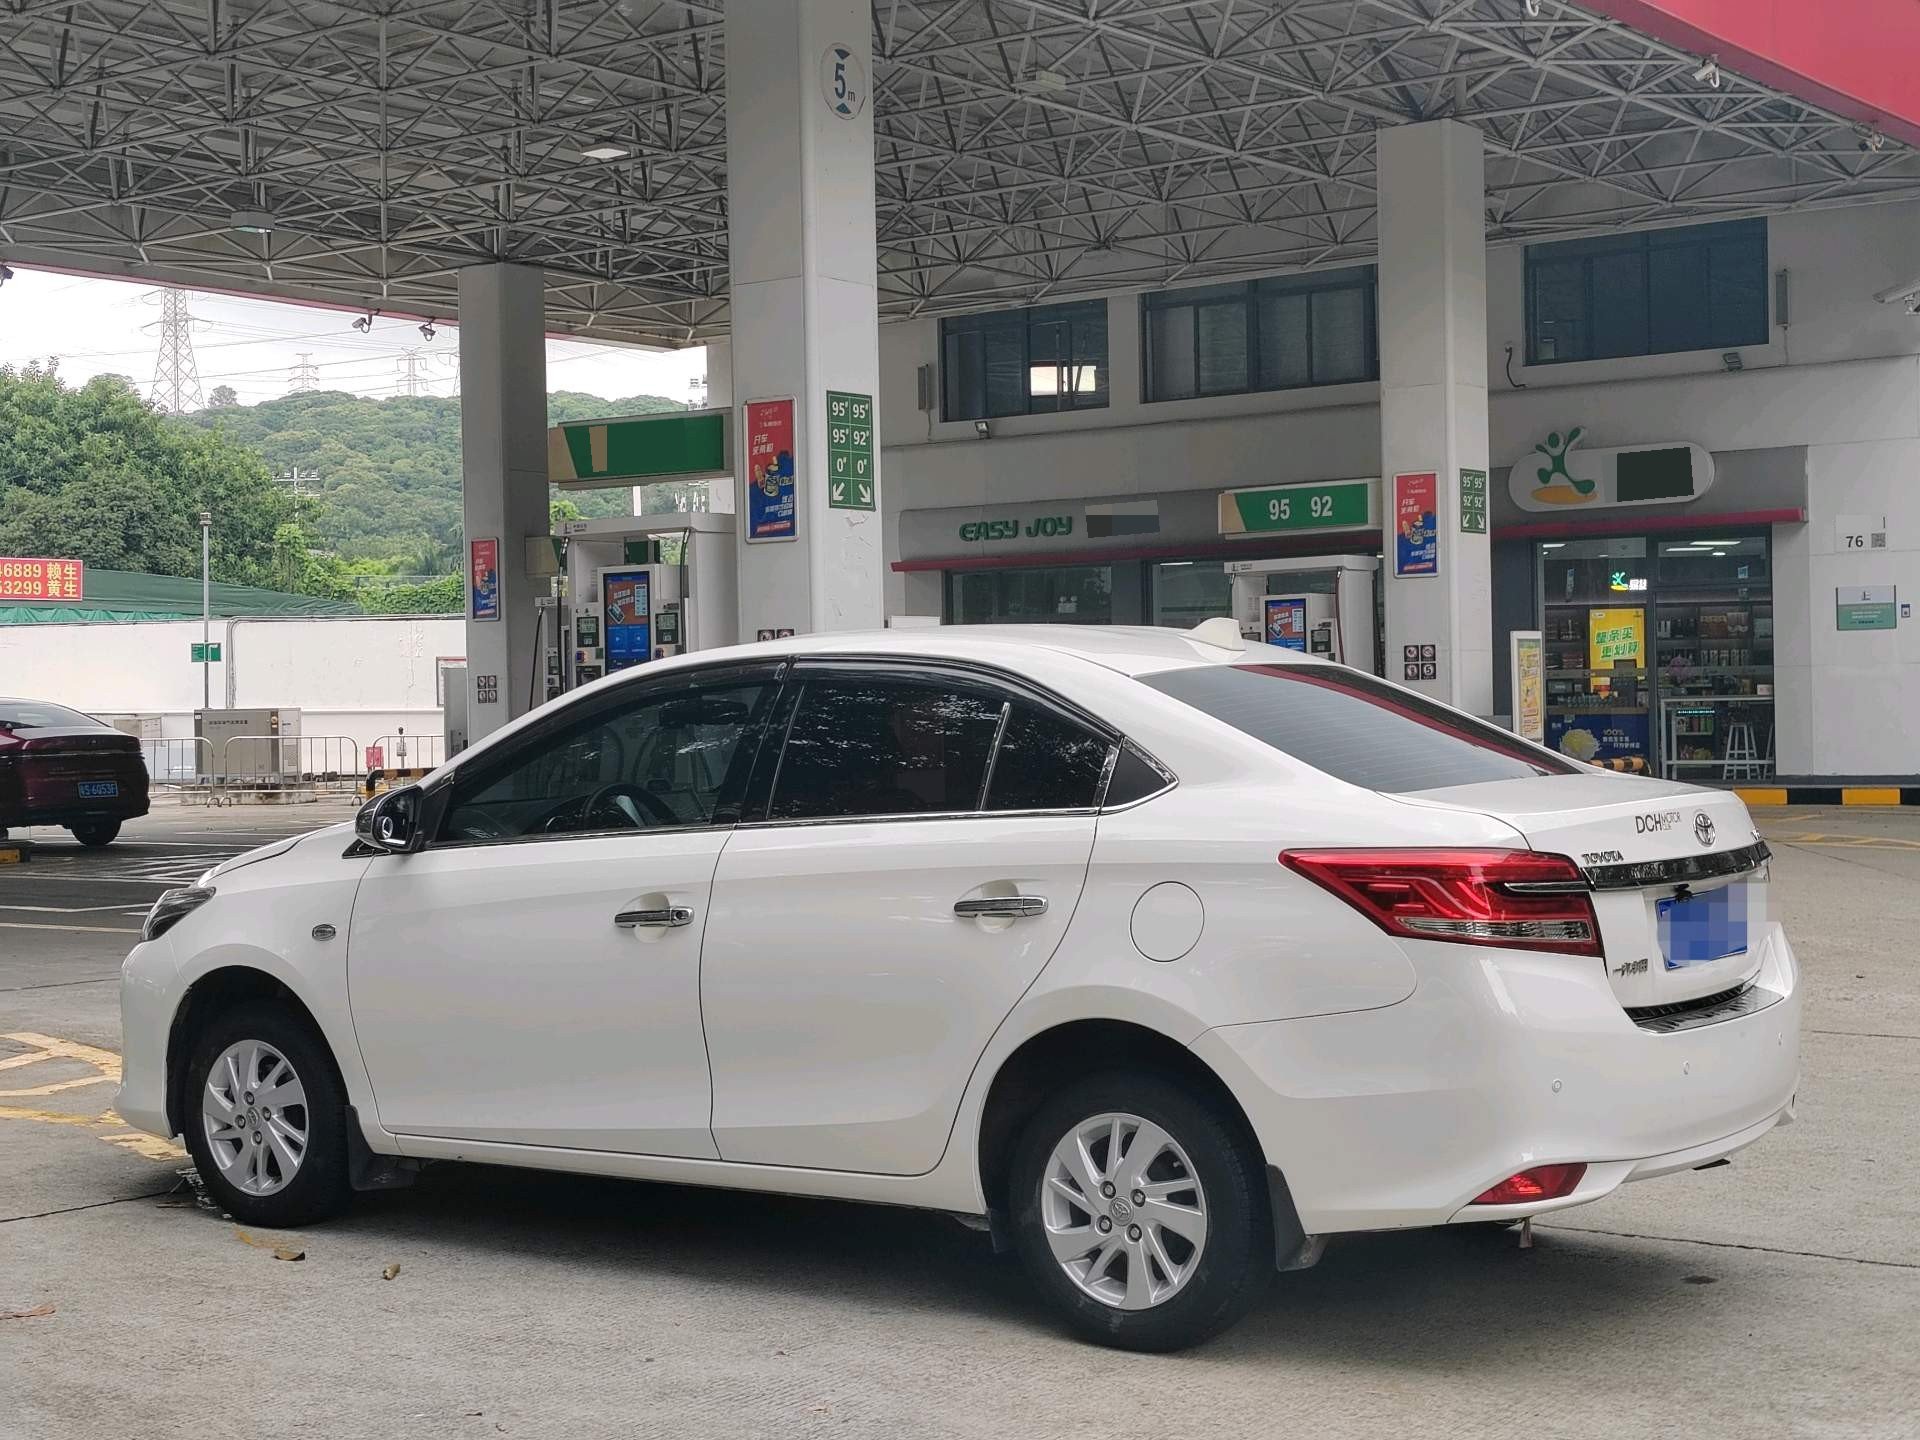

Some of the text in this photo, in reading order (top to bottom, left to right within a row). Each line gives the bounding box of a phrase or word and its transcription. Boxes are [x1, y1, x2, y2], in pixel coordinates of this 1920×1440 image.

[1268, 495, 1333, 520] 95 92
[958, 515, 1073, 543] EASY JOY
[1845, 535, 1864, 548] 76
[0, 561, 78, 580] 6889 赖生
[0, 580, 78, 597] 3299 黄生
[1635, 813, 1662, 834] DCH
[1582, 850, 1625, 866] TOYOTA
